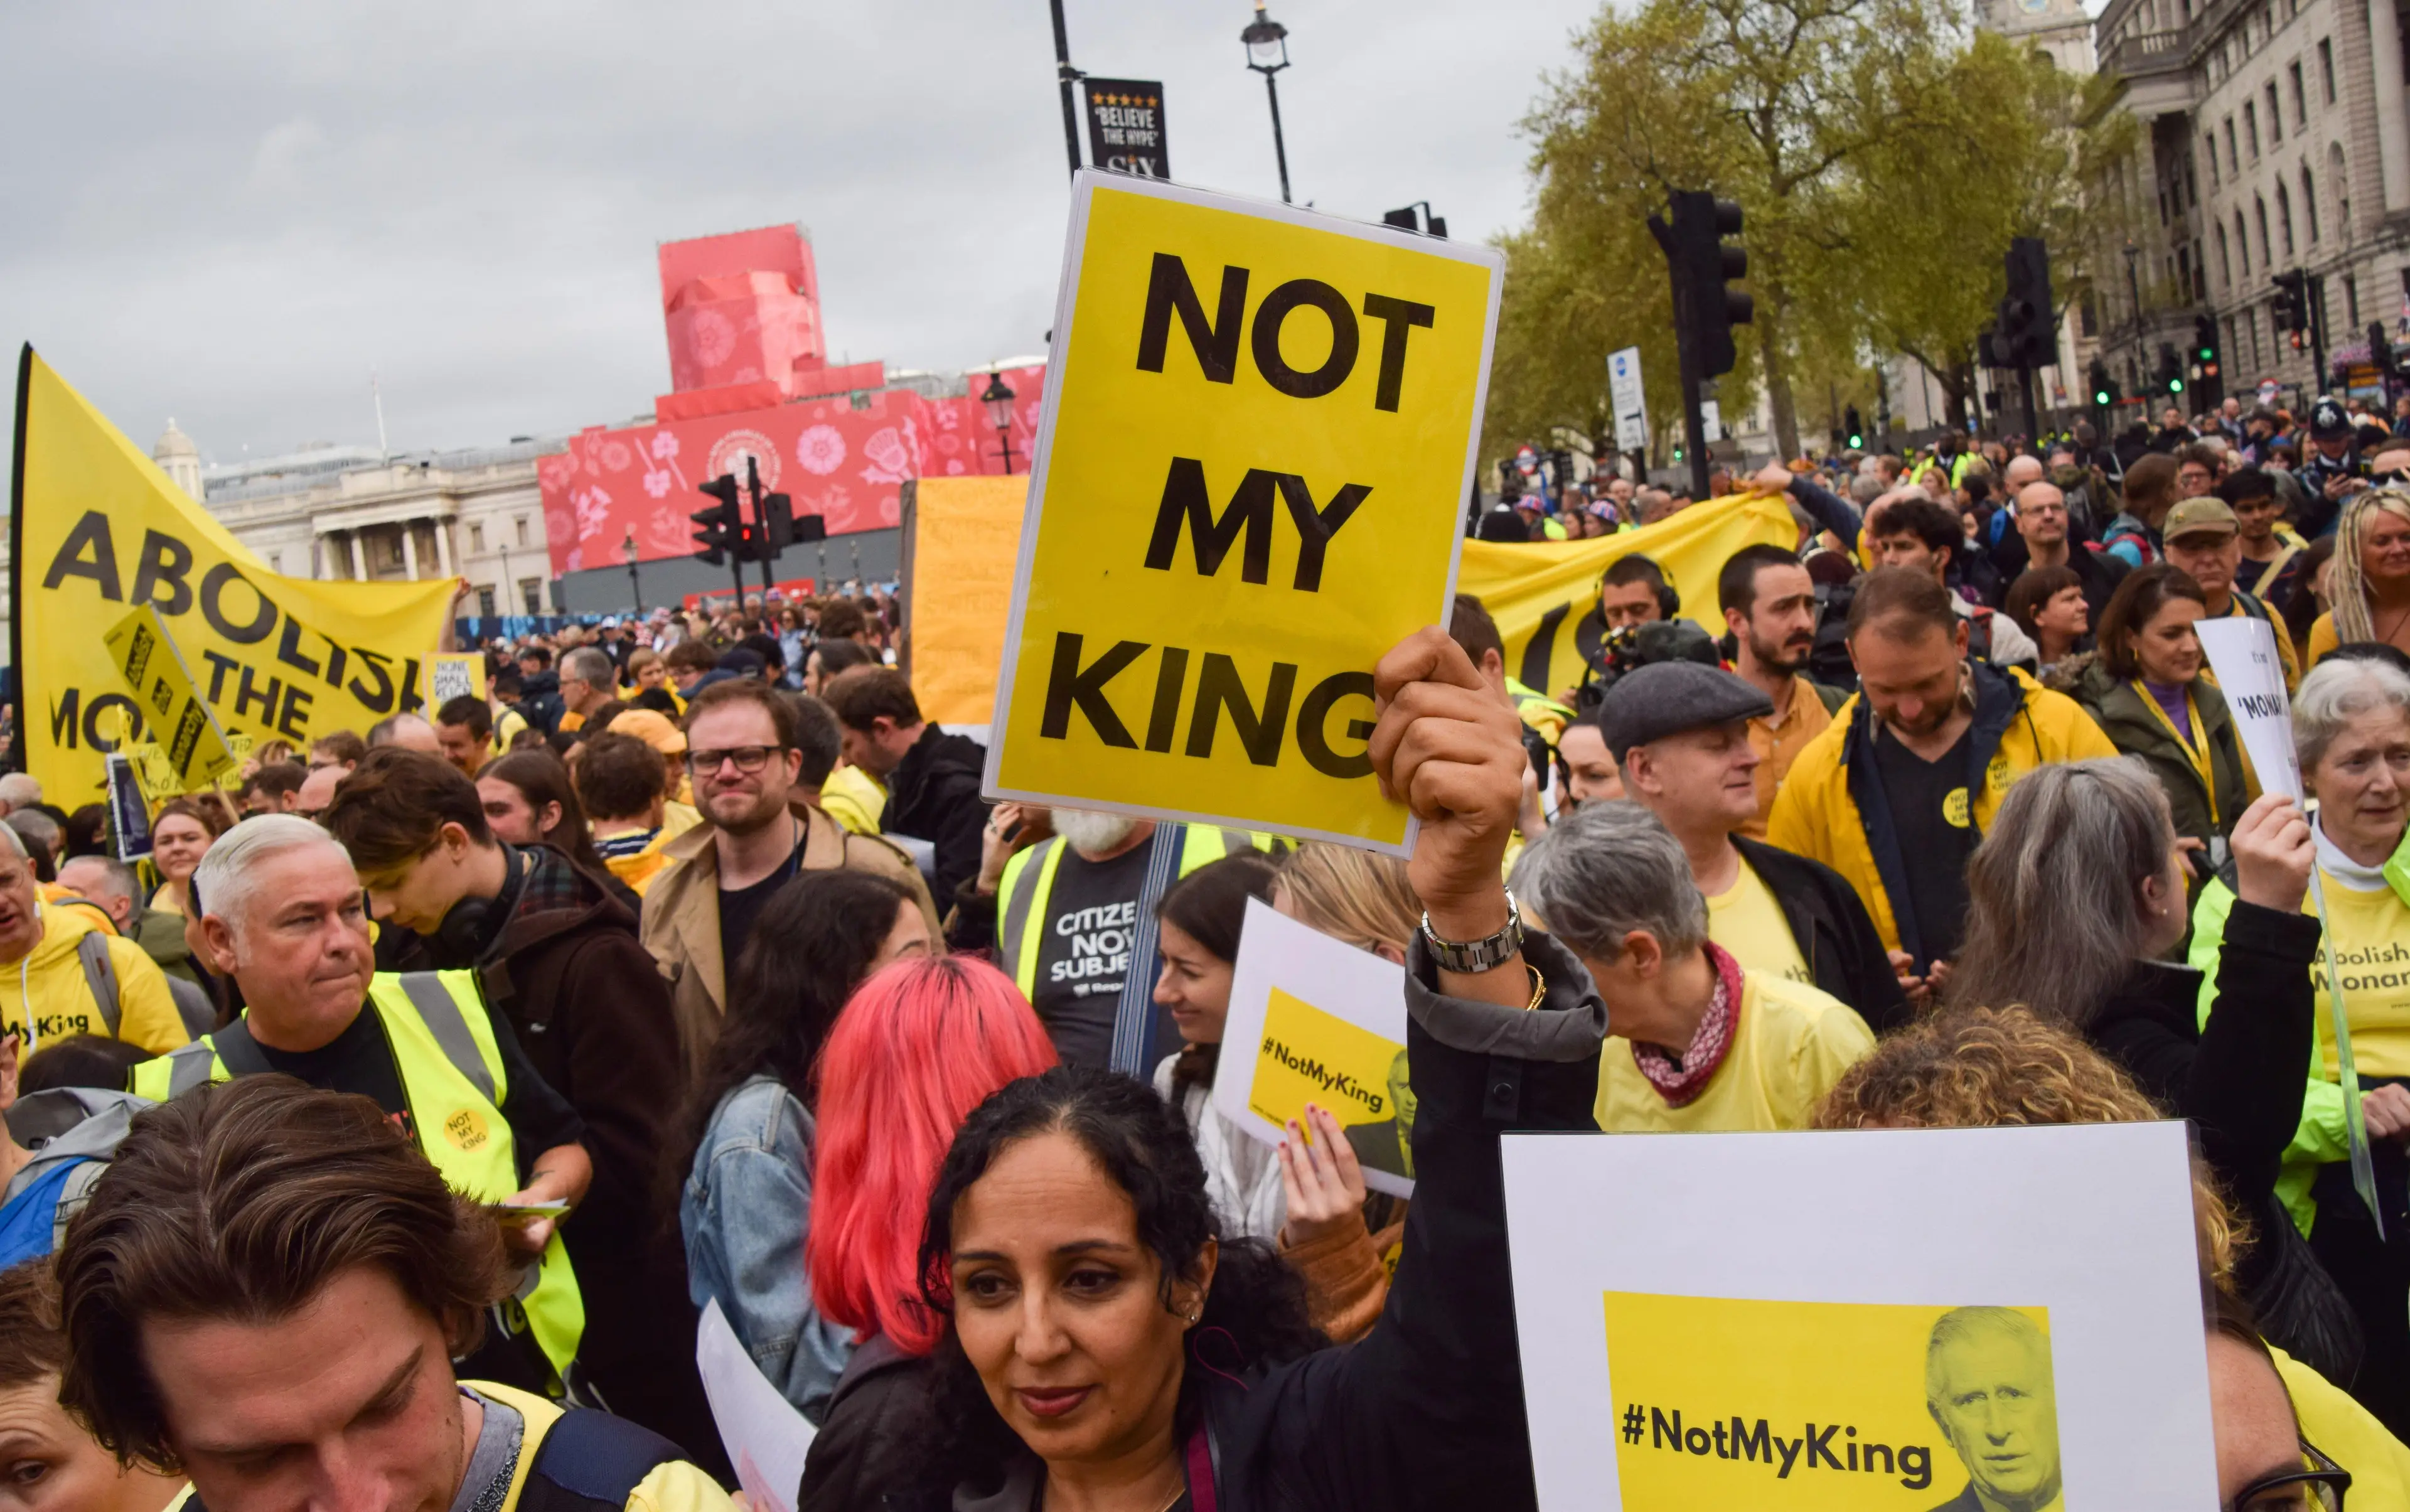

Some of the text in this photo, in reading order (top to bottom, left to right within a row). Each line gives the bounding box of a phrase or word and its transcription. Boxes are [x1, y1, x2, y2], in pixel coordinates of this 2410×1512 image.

[1102, 127, 1125, 145] THE
[1137, 252, 1435, 413] NOT
[1144, 456, 1374, 593] MY
[203, 648, 314, 742] THE
[1040, 631, 1379, 779] KING
[1056, 900, 1136, 936] CITIZE
[1051, 951, 1130, 982] SUBJE
[2313, 942, 2410, 965] Abolish
[1262, 1036, 1383, 1113] #NotMyKing
[448, 1111, 470, 1132] NOT
[458, 1124, 473, 1140] MY
[460, 1132, 486, 1150] KING
[1622, 1403, 1932, 1491] #NotMyKing
